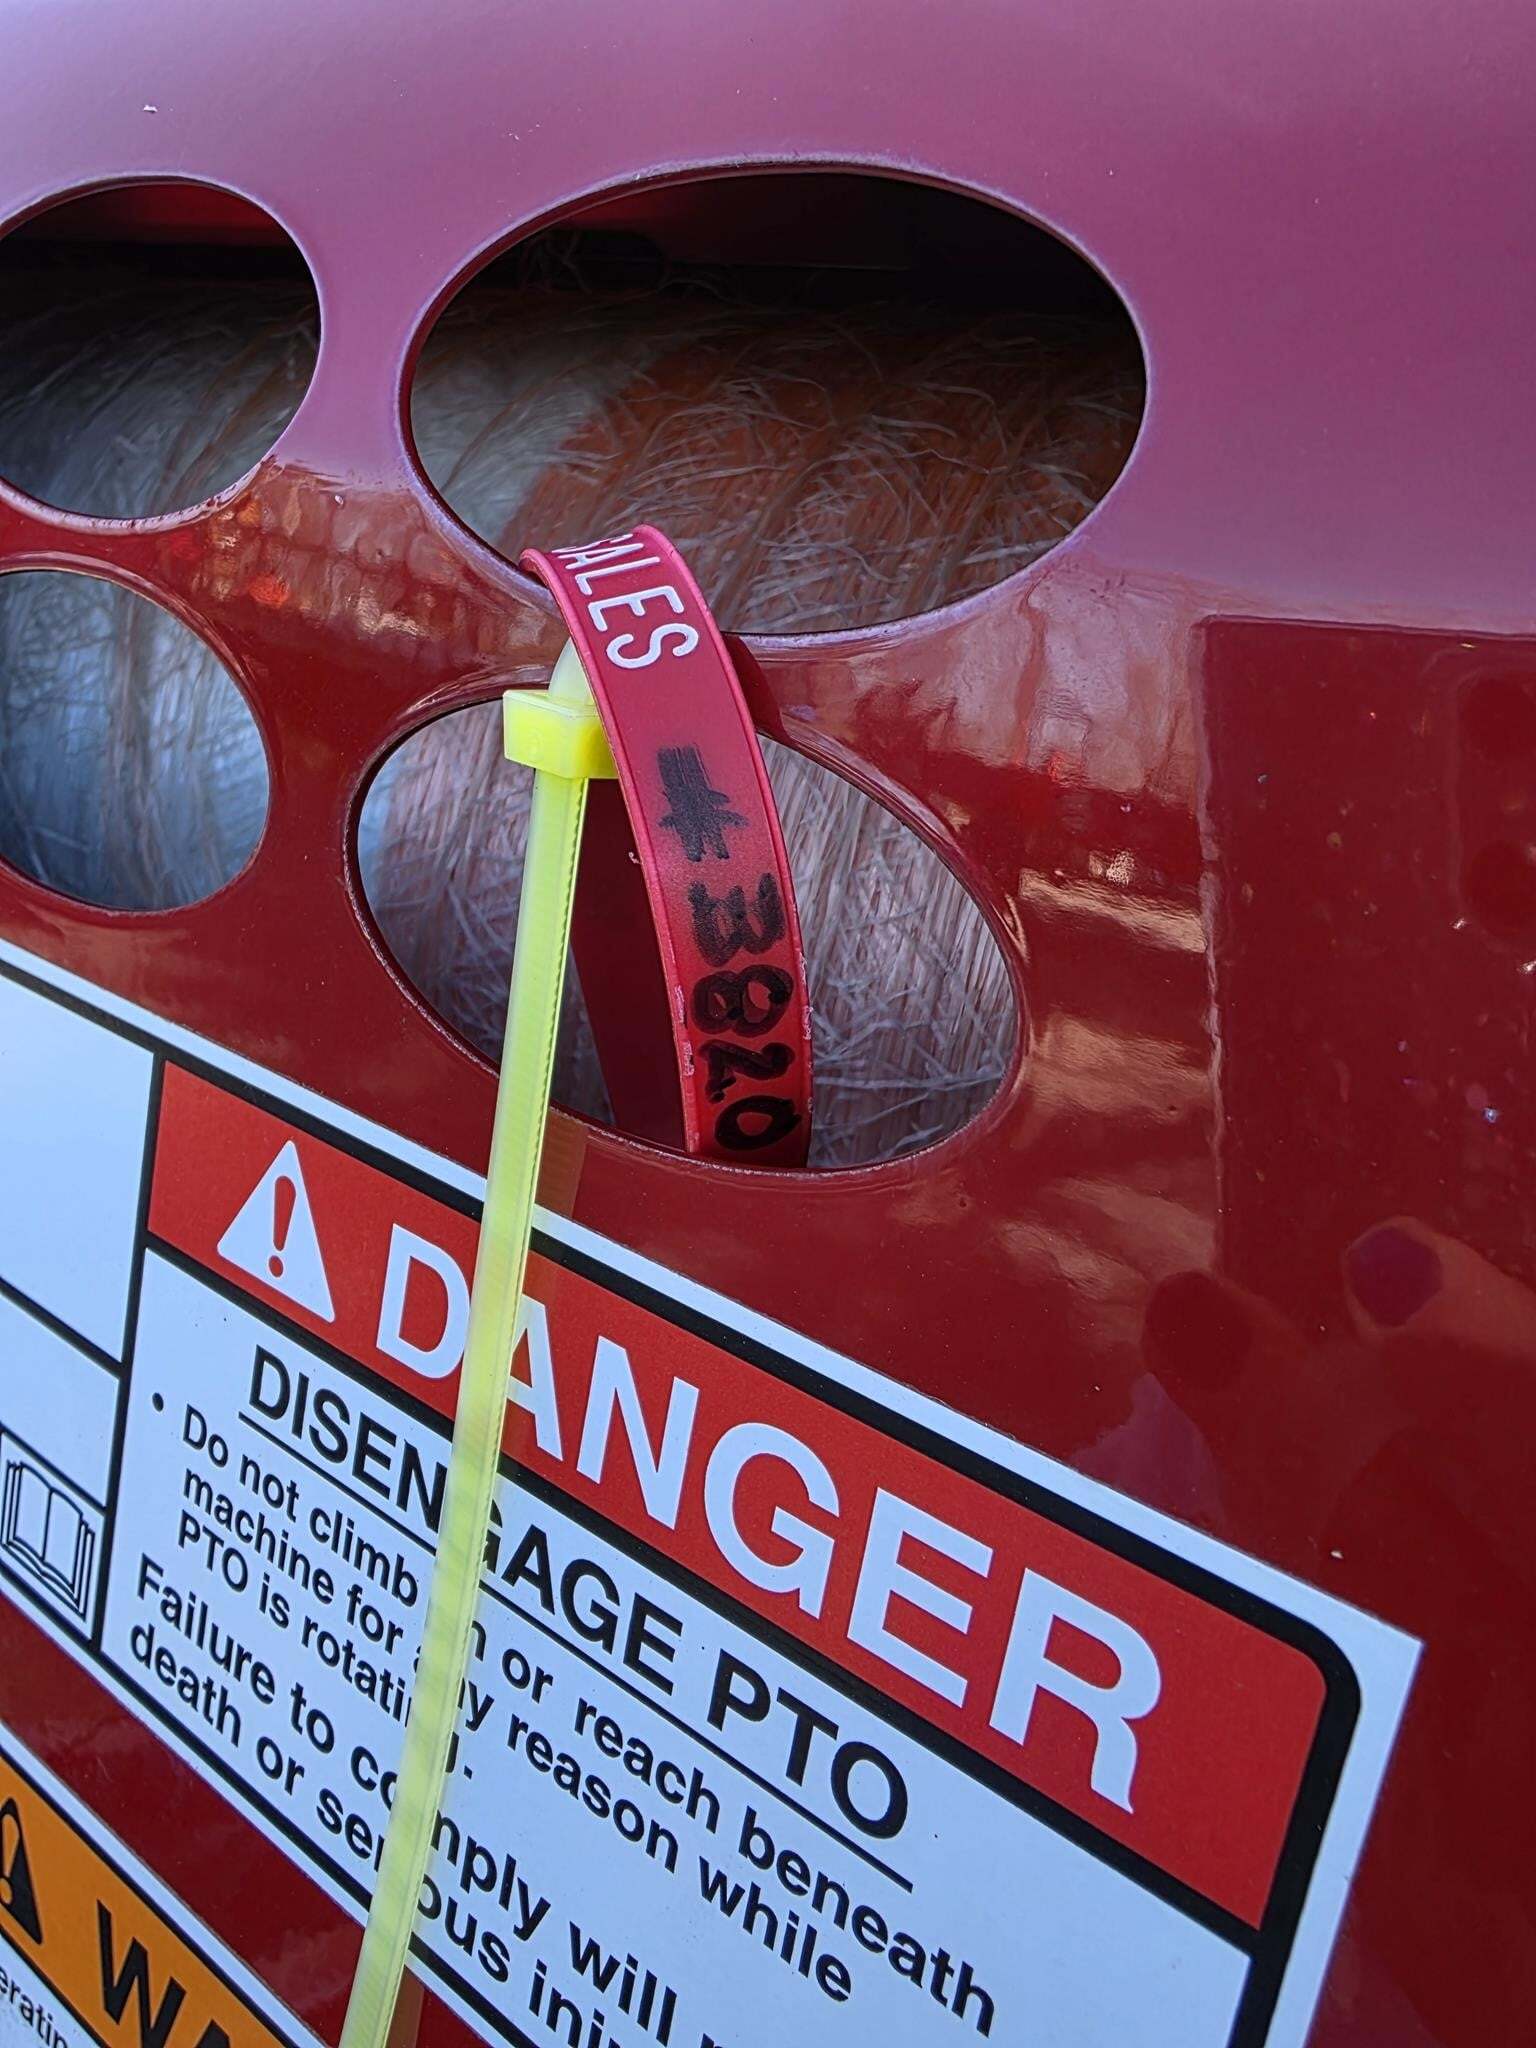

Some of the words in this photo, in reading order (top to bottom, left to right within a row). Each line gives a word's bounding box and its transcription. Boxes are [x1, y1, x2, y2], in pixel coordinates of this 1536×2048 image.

[130, 1623, 242, 1748] death
[255, 1735, 305, 1796] or
[178, 1508, 249, 1594] PTO
[259, 1571, 291, 1629] is
[182, 1403, 229, 1468] Do
[238, 1453, 299, 1523] not
[309, 1507, 419, 1608] climb
[501, 1648, 554, 1704] or
[574, 1697, 720, 1834] reach
[738, 1805, 995, 2038] beneath
[182, 1467, 335, 1606] machine
[346, 1583, 404, 1656] for
[507, 1713, 679, 1874] reason
[699, 1855, 852, 2002] while
[376, 1222, 1162, 1815] DANGER
[706, 1648, 909, 1840] PTO
[136, 1552, 275, 1705] Failure
[290, 1681, 335, 1755] to
[569, 1920, 678, 2048] will
